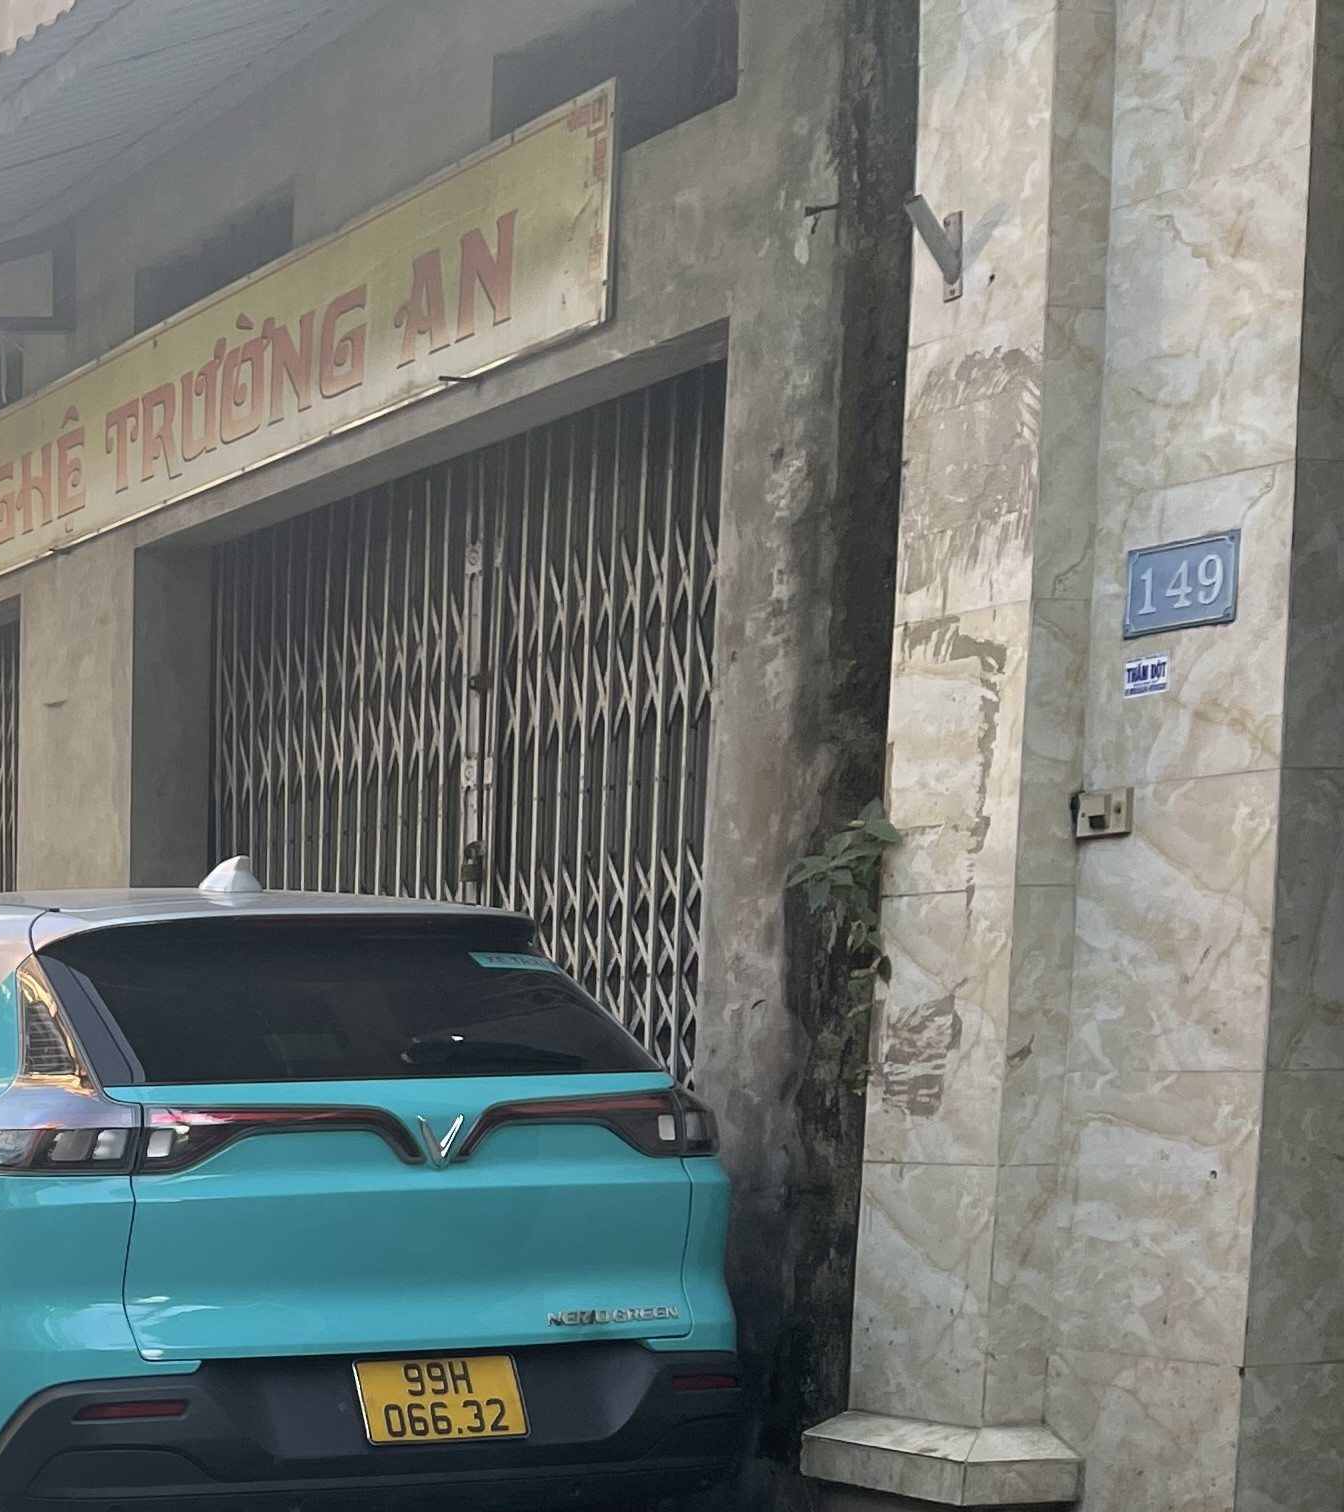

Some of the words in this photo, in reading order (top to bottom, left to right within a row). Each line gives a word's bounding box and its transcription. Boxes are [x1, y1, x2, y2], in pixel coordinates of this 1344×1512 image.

[105, 283, 368, 493] TRƯỜNG
[394, 208, 519, 369] AN
[1137, 553, 1225, 615] 149
[611, 1305, 680, 1323] GREEN
[403, 1360, 474, 1397] 99H
[383, 1397, 510, 1438] 066.32
